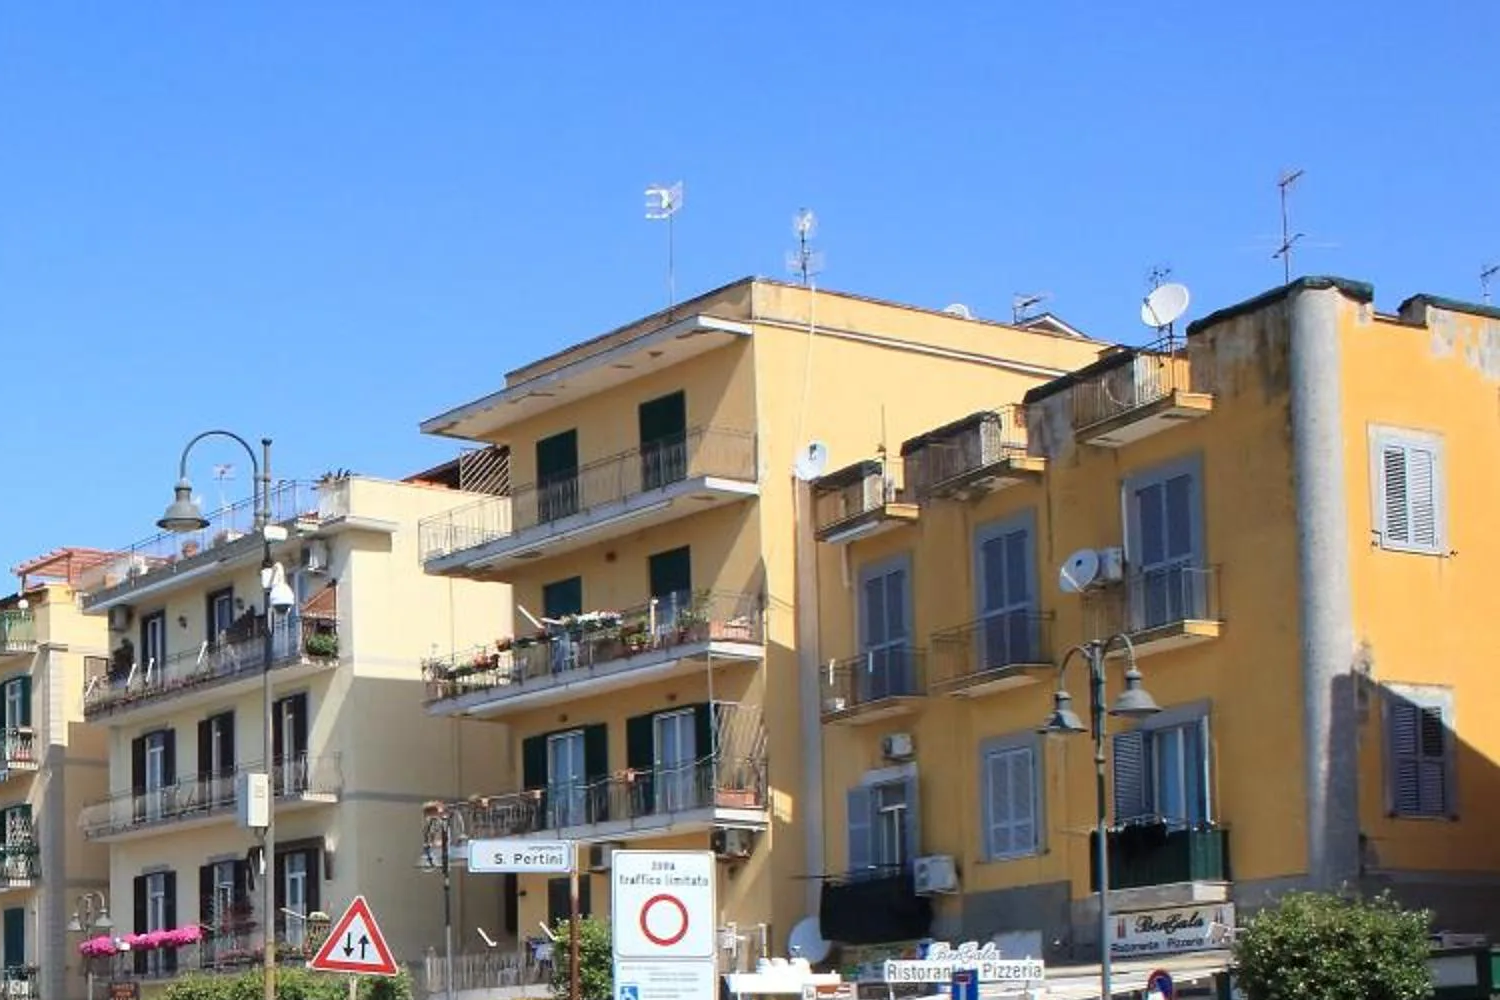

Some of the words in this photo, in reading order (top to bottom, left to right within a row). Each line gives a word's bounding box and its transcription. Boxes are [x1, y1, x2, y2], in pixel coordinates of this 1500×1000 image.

[494, 853, 507, 865] S.
[513, 853, 563, 865] Pertini
[619, 874, 661, 885] traffico
[664, 874, 709, 887] limitato
[982, 962, 1043, 979] Pizzeria
